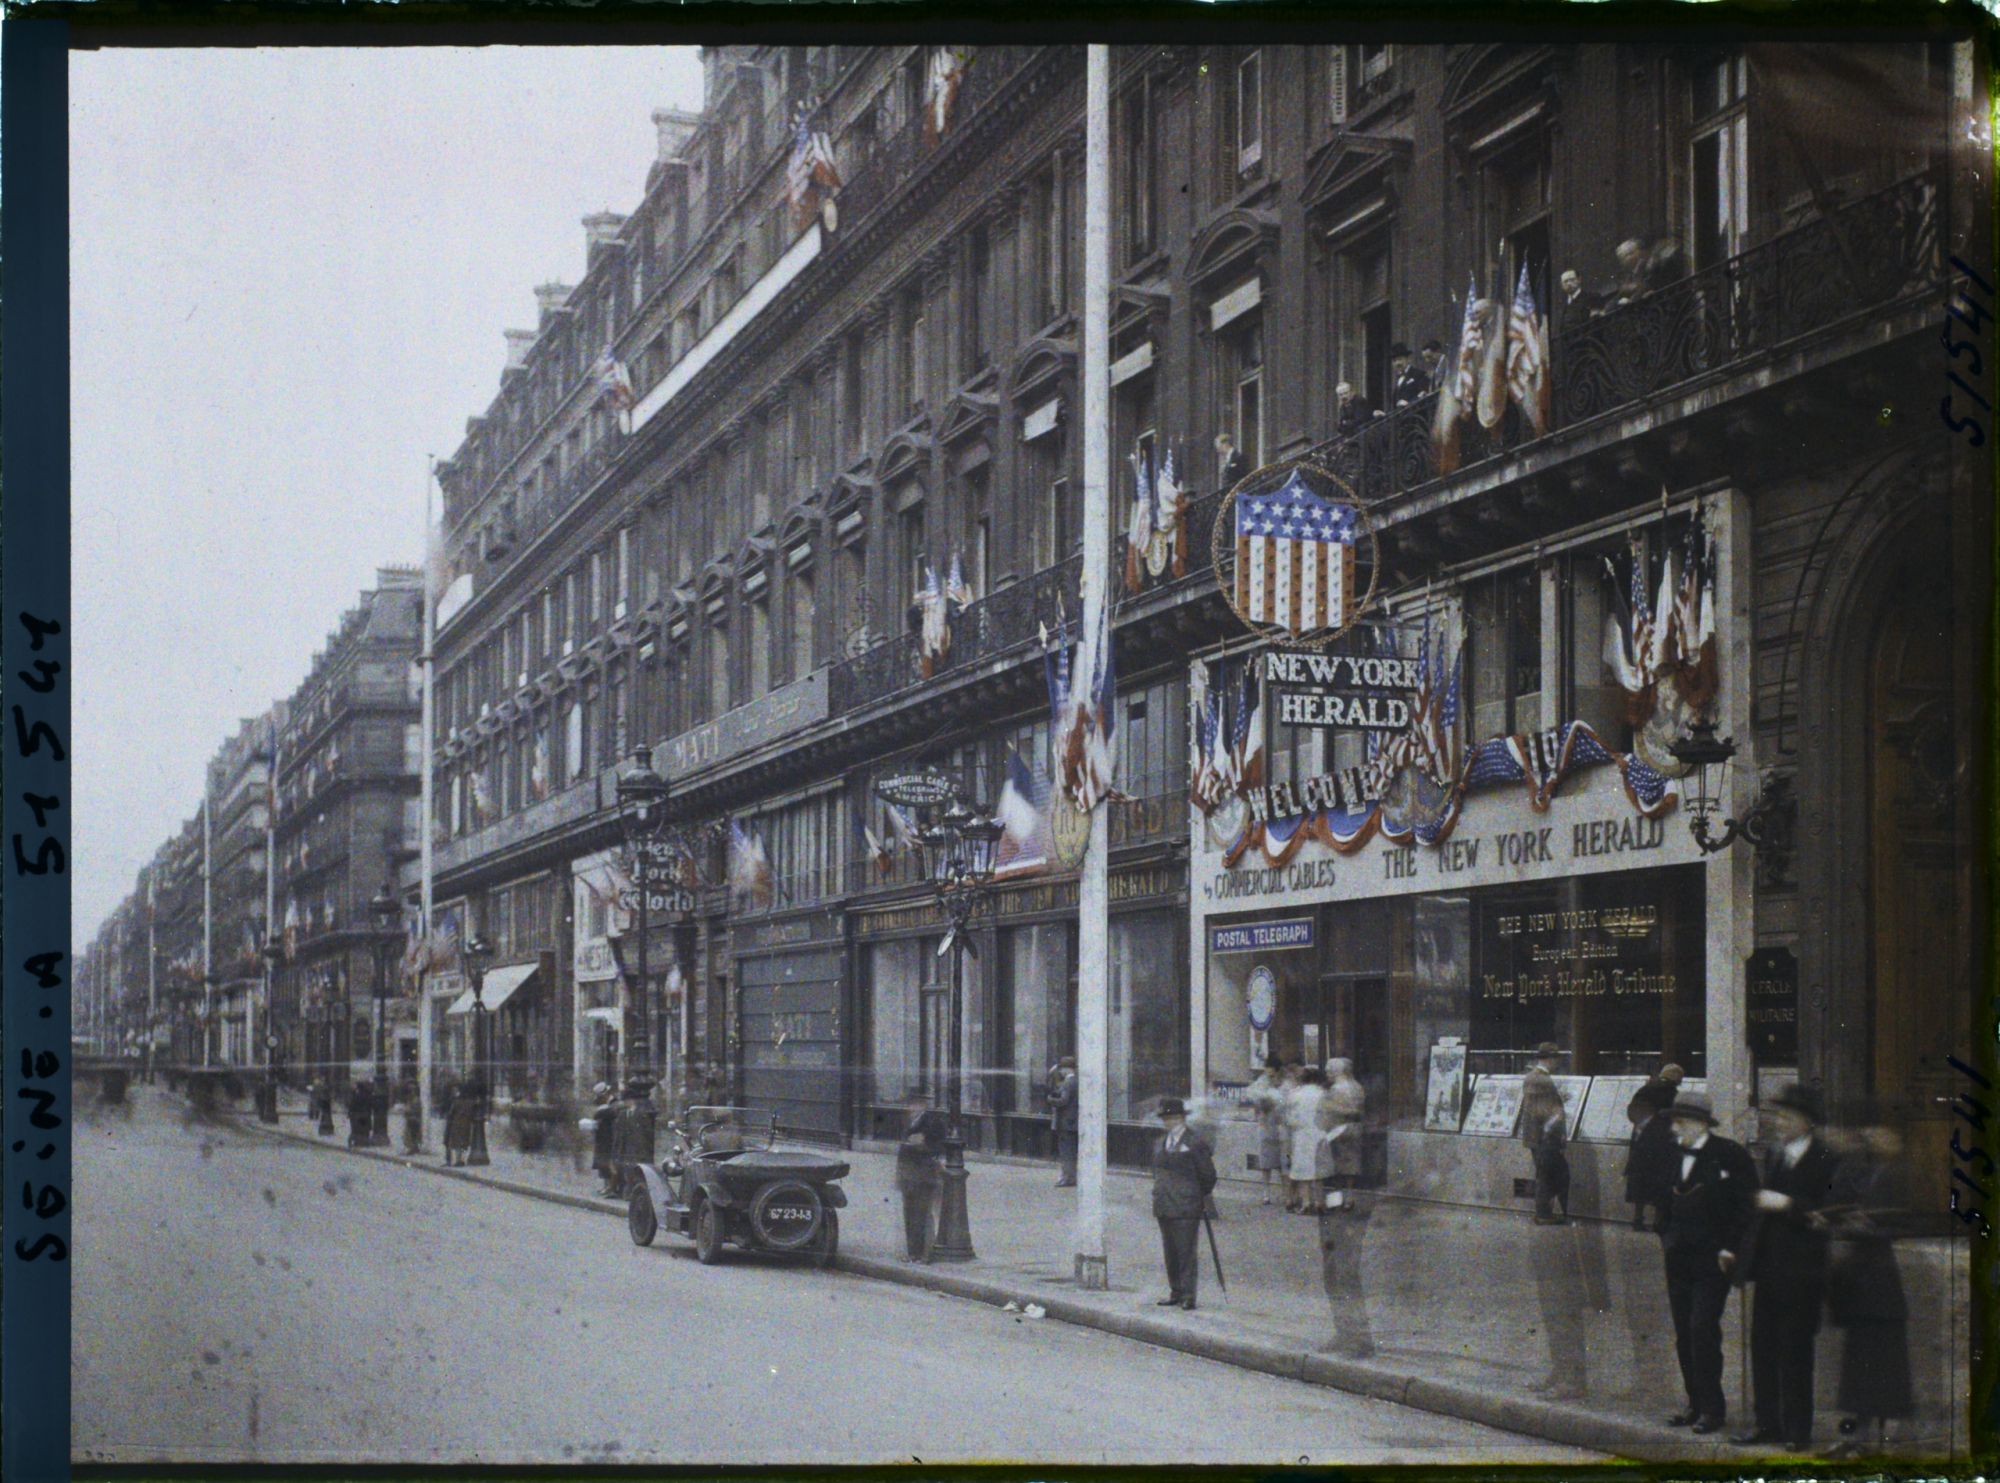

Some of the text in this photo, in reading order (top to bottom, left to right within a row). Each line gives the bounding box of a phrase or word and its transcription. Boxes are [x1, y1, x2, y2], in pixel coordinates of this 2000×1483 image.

[1267, 652, 1421, 688] NEW YORK
[1280, 693, 1410, 728] HERALD
[1382, 815, 1665, 879] THE NEW YORK HERALD
[1214, 867, 1285, 899] COMMERCIAL
[1288, 859, 1336, 891] CABLES
[1217, 924, 1308, 948] POSTAL TELEGRAPH
[1499, 916, 1521, 934] THE
[1529, 913, 1556, 932] NEW
[1561, 910, 1598, 929] YORK
[1557, 970, 1607, 996] Herald
[1612, 968, 1677, 994] Tribune
